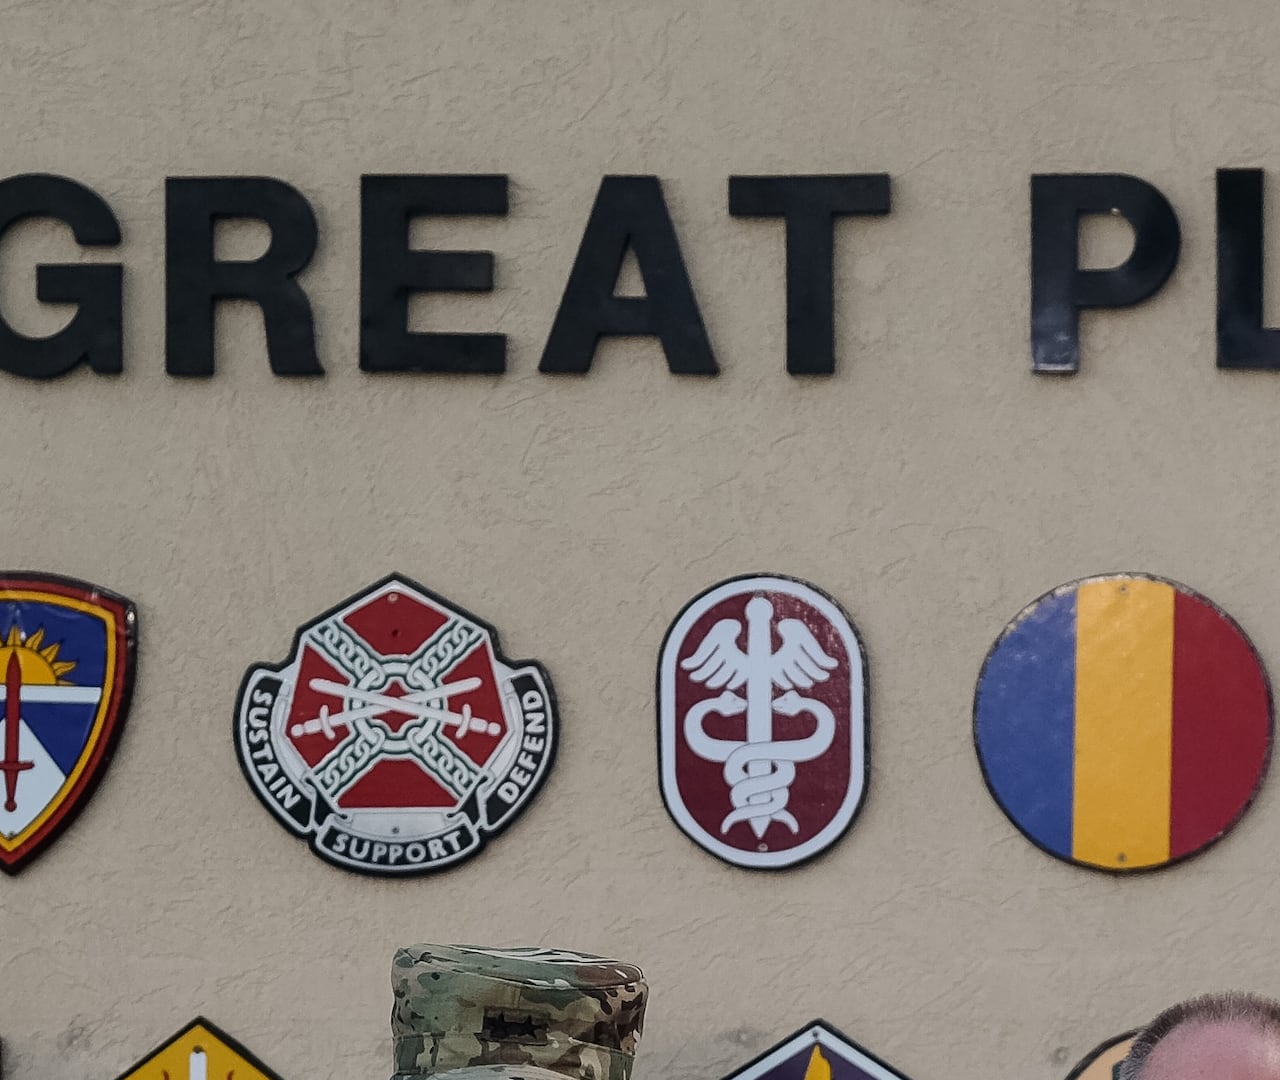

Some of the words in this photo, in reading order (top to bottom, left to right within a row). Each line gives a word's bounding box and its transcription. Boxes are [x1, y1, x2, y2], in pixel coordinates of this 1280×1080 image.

[247, 688, 302, 810] SUSTAIN
[332, 830, 464, 864] SUPPORT
[496, 689, 539, 804] DEFEND
